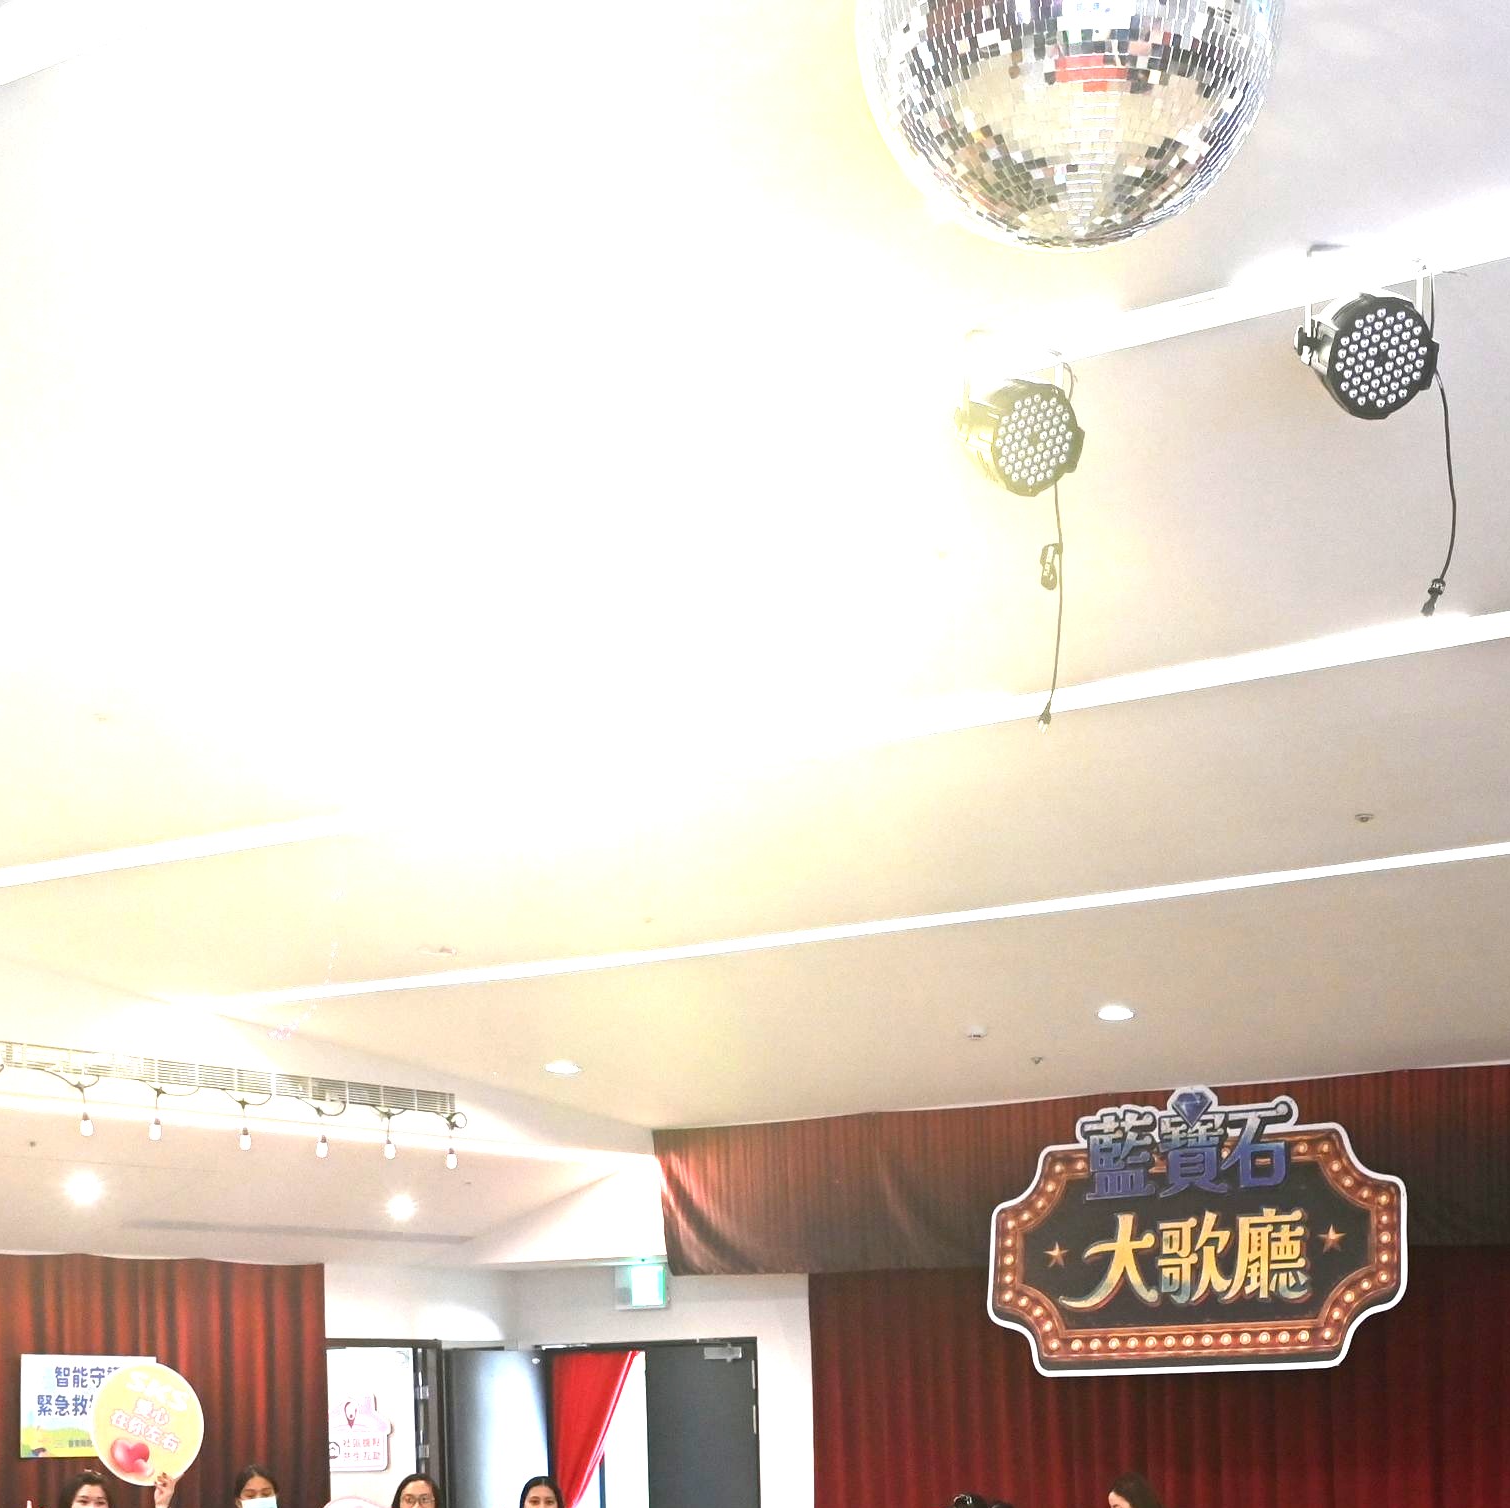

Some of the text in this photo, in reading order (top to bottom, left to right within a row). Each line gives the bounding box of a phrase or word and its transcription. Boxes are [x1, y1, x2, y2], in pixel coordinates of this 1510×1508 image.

[1081, 1100, 1292, 1201] 藍寶石
[1059, 1207, 1309, 1309] 大歌廳
[37, 1394, 94, 1417] 緊急救
[54, 1366, 120, 1389] 智能守
